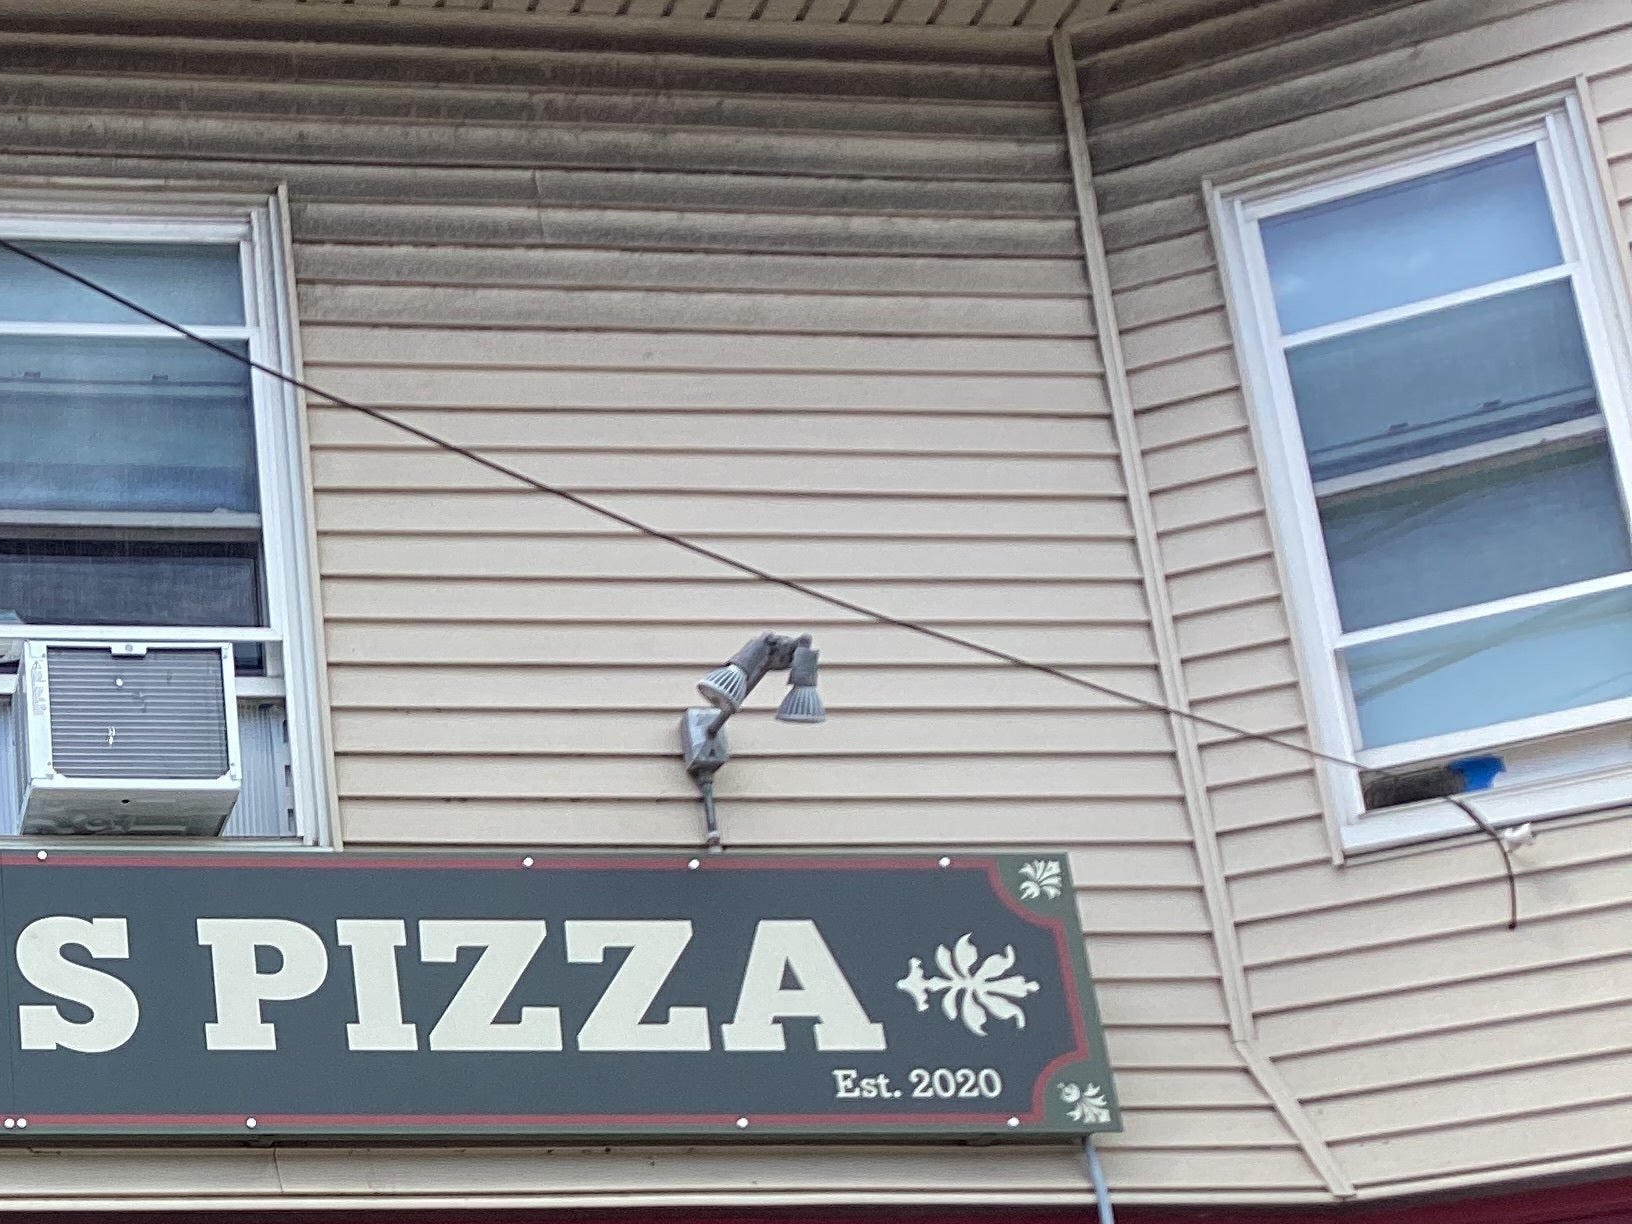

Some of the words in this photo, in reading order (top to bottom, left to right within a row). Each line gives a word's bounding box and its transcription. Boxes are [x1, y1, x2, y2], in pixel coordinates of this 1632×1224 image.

[196, 918, 887, 1051] PIZZA
[831, 1068, 903, 1100] Est.
[909, 1067, 1003, 1100] 2020
